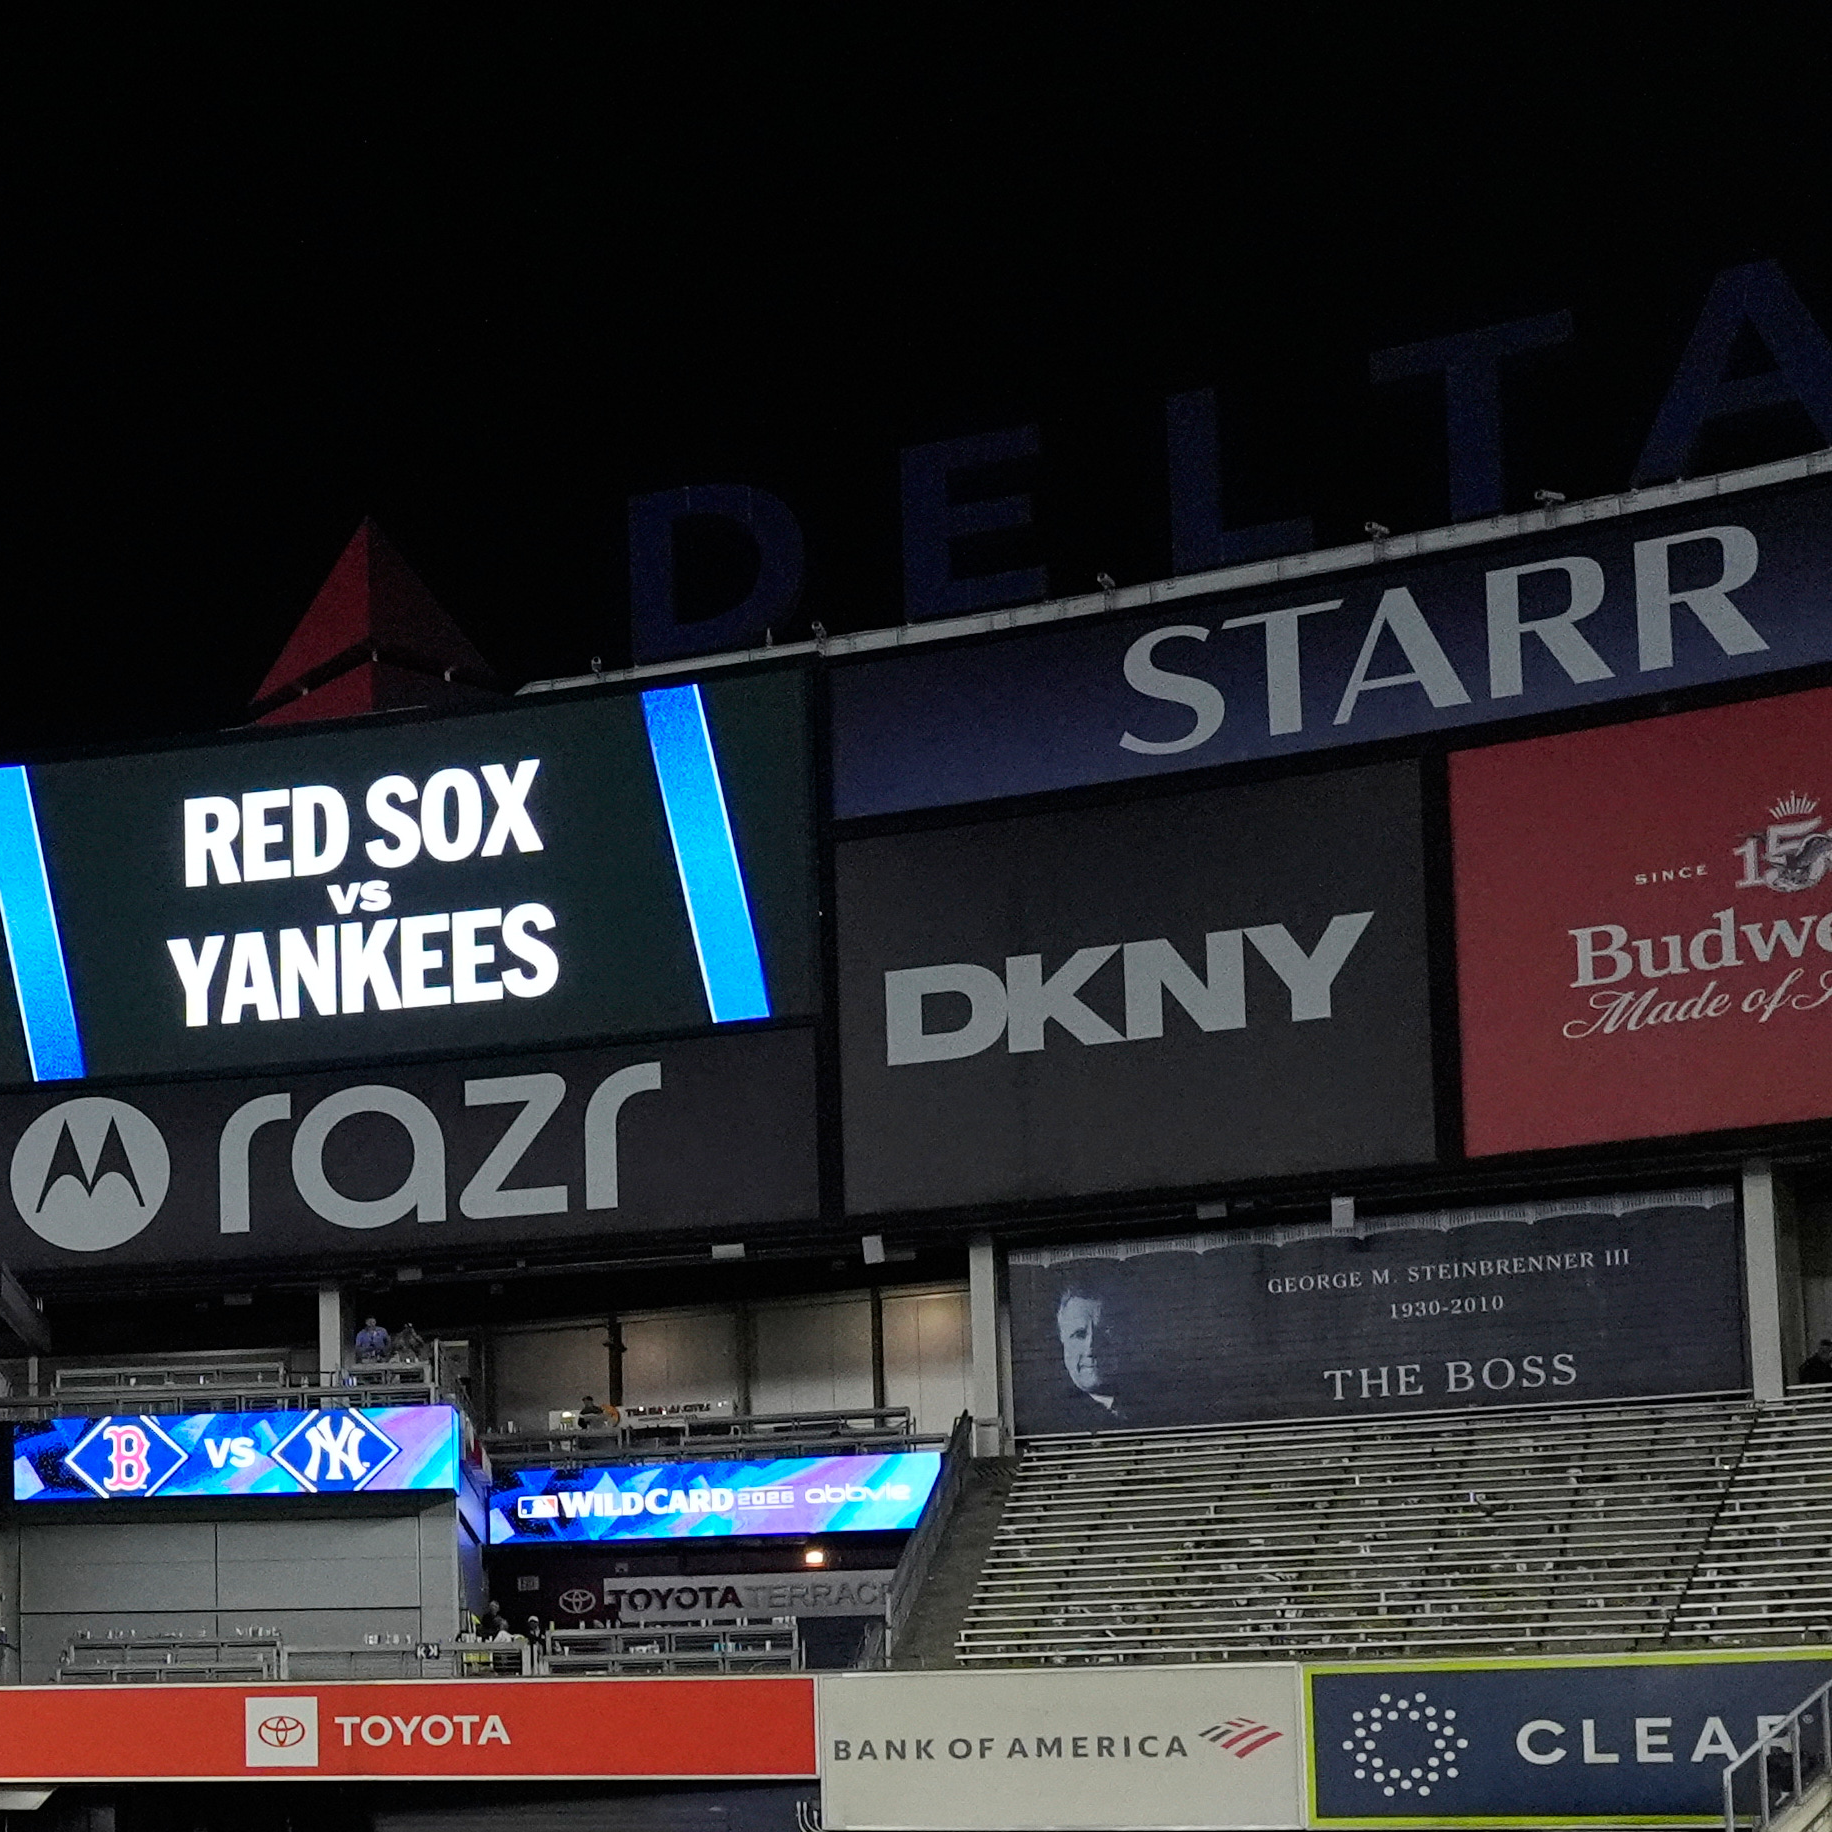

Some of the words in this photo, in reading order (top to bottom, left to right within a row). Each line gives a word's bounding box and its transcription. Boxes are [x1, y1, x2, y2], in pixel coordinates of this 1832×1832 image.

[627, 256, 1832, 670] DELTA
[1119, 524, 1772, 758] STARR
[182, 784, 350, 889] RED
[365, 757, 544, 870] SOX
[1634, 863, 1708, 886] SINCE
[166, 901, 560, 1029] YANKEES
[884, 910, 1377, 1067] DKNY
[1563, 980, 1731, 1039] Made
[1741, 967, 1805, 1023] of
[218, 1061, 663, 1235] razr
[1267, 1271, 1363, 1295] GEORGE
[1372, 1268, 1398, 1286] M.
[1408, 1250, 1595, 1284] STEINBRENNER
[1604, 1248, 1631, 1267] III
[1389, 1294, 1505, 1320] 1930-2010
[1322, 1363, 1425, 1401] THE
[1445, 1353, 1578, 1394] BOSS
[804, 1482, 911, 1504] abbvie
[608, 1585, 745, 1613] TOYOTA
[333, 1714, 512, 1747] TOYOTA
[833, 1738, 935, 1762] BANK
[948, 1737, 996, 1760] OF
[1007, 1735, 1190, 1760] AMERICA
